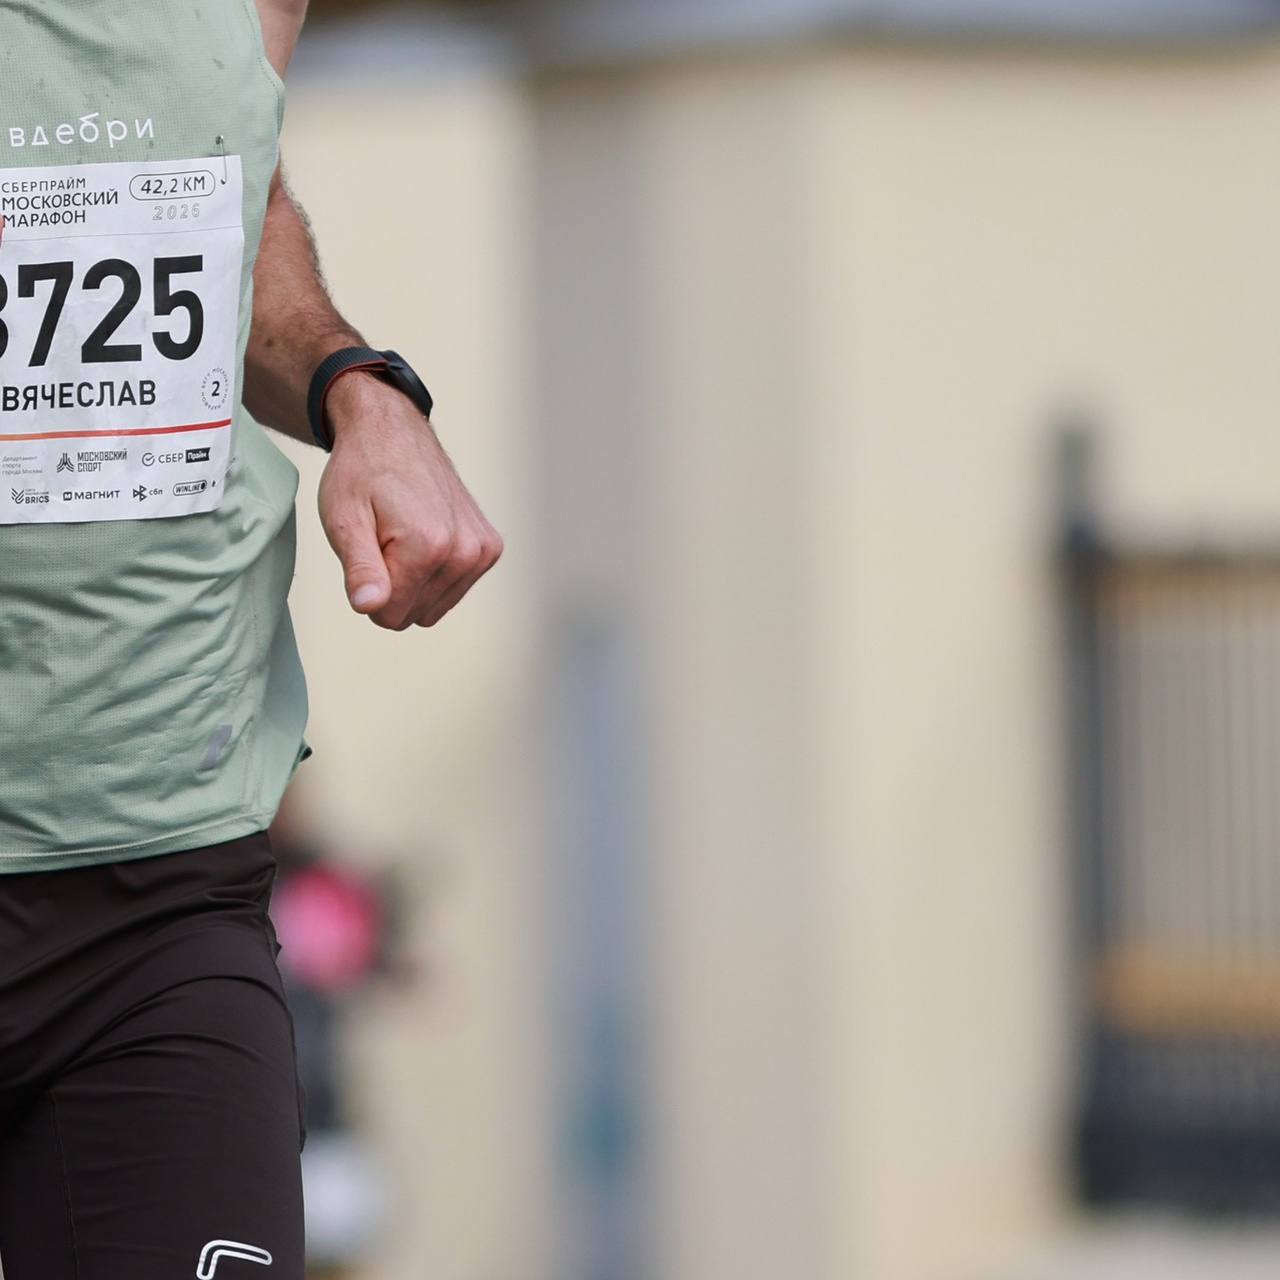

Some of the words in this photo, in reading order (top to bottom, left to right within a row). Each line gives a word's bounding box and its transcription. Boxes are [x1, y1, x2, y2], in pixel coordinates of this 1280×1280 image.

[9, 112, 154, 148] вдебри
[1, 177, 86, 193] СБЕРПРАЙМ
[140, 178, 178, 196] 42,2
[1, 189, 119, 211] МОСКОВСКИЙ
[2, 210, 86, 228] МАРАФОН
[152, 202, 200, 221] 2026
[2, 379, 156, 412] ВЯЧЕСЛАВ
[211, 380, 220, 397] 2
[77, 448, 127, 462] МОСКОВСКИЙ
[158, 453, 184, 464] СБЕР
[77, 462, 102, 473] СПОРТ
[25, 495, 50, 504] BRICS
[74, 489, 120, 500] магнит
[149, 487, 163, 496] сбп
